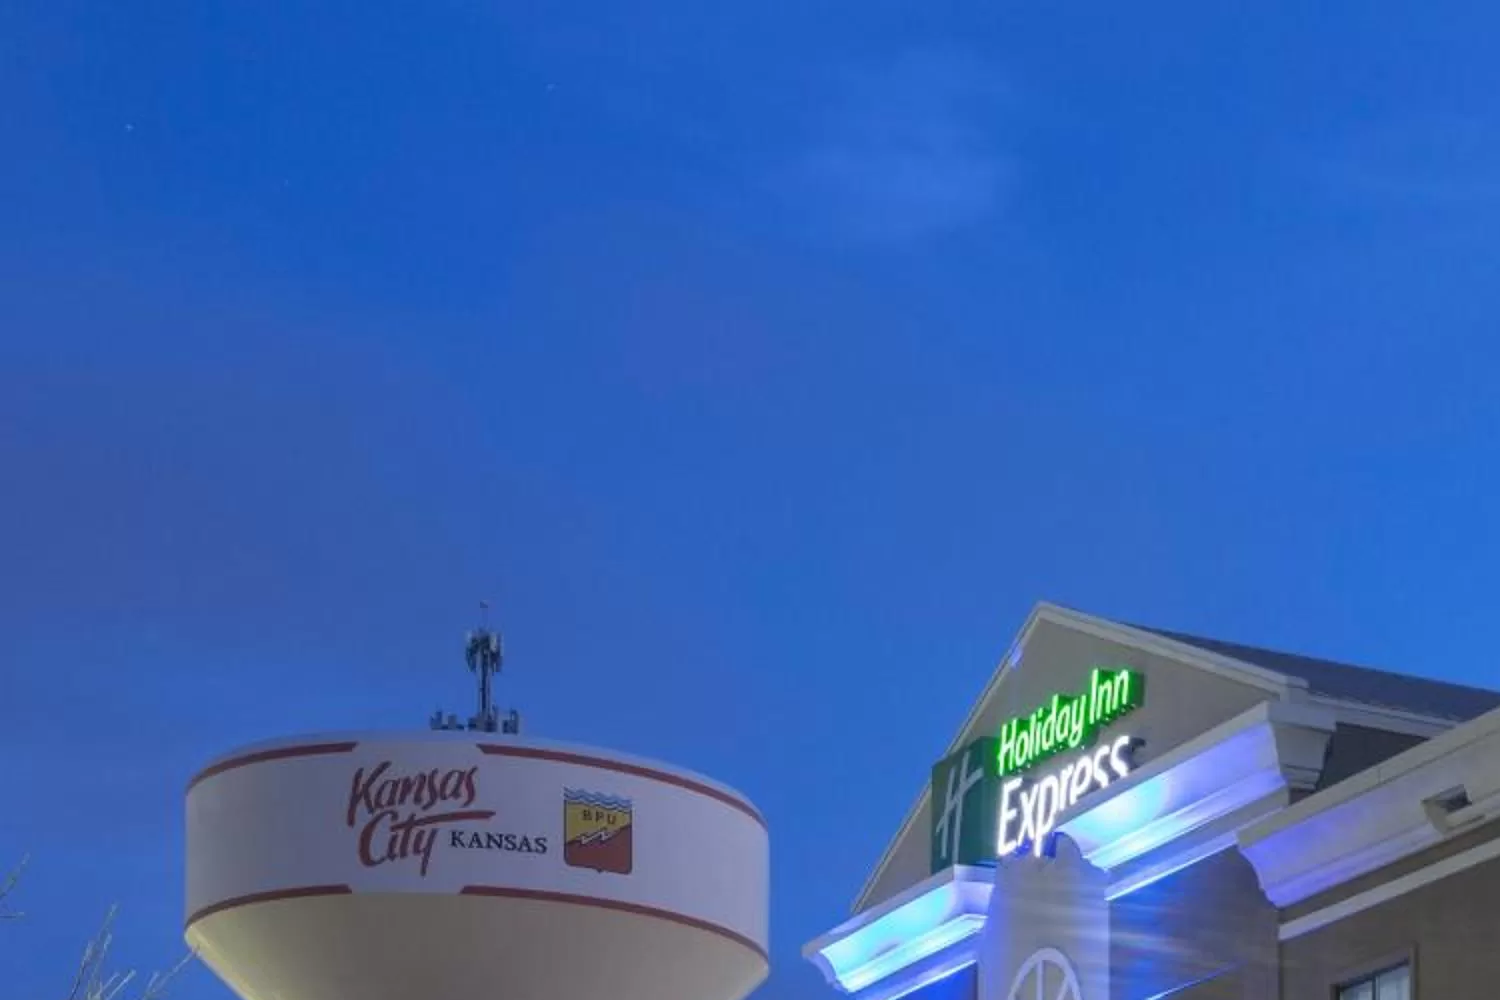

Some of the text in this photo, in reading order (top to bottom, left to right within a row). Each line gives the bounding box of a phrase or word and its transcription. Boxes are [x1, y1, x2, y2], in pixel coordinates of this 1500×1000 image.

[997, 667, 1130, 777] Holiday Inn
[346, 761, 478, 827] Kansas
[997, 735, 1130, 857] Express
[359, 809, 548, 877] City KANSAS
